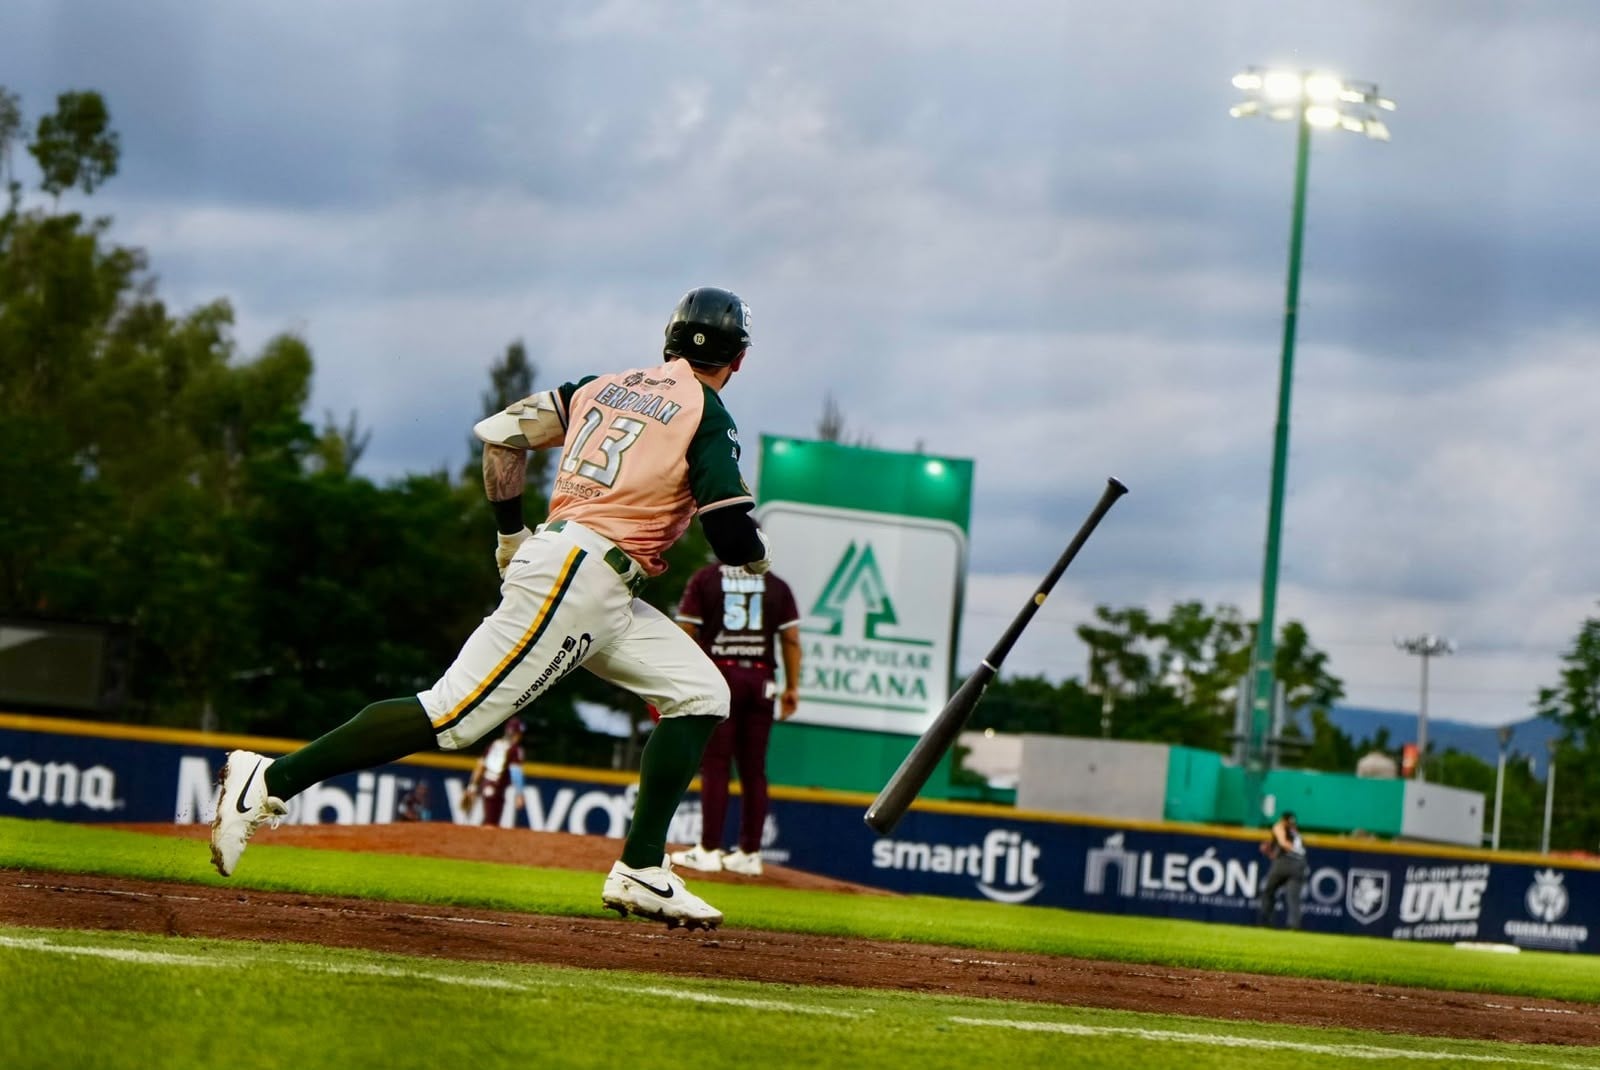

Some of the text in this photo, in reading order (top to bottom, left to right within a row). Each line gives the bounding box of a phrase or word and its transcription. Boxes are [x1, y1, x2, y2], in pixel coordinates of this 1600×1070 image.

[560, 406, 647, 489] 13
[723, 593, 763, 631] 51
[512, 649, 568, 709] caliente.mx
[833, 643, 933, 671] POPULAR
[798, 664, 929, 701] EXICANA
[176, 755, 396, 825] Mbil
[1141, 848, 1258, 898] LEÓN
[1399, 879, 1488, 923] UNE
